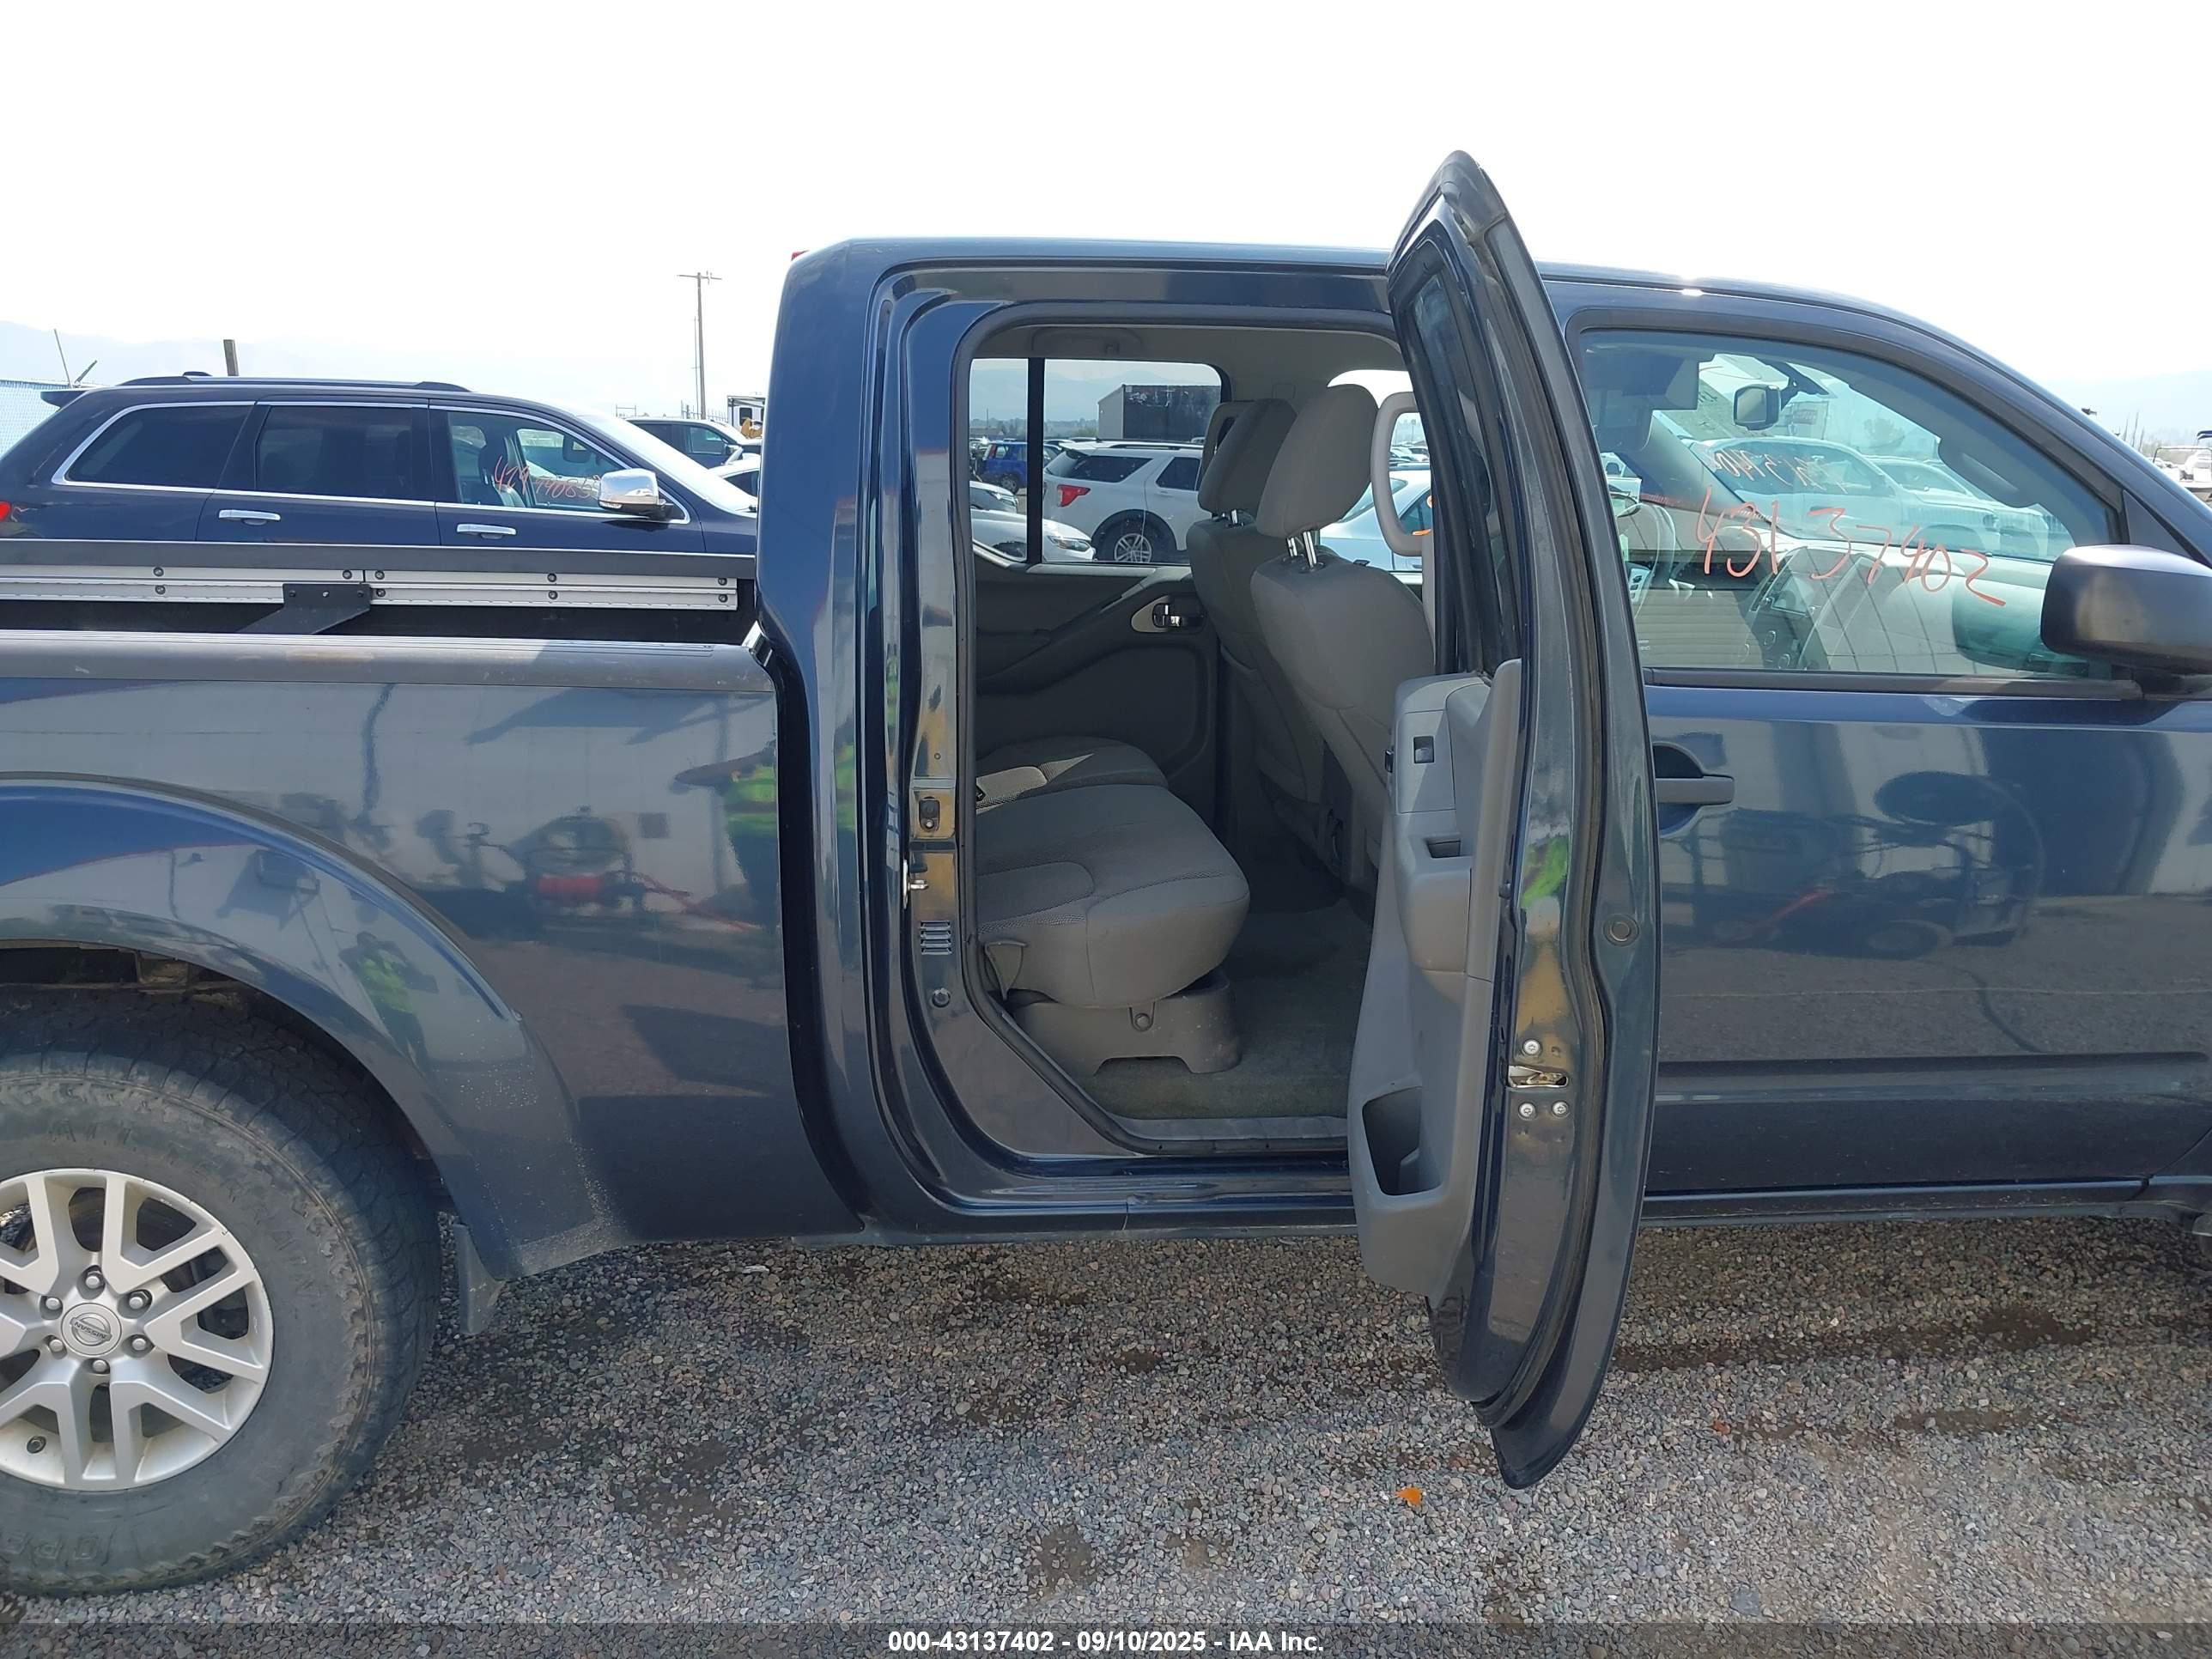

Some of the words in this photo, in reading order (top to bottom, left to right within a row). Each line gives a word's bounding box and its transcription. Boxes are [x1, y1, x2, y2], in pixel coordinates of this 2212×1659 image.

[1697, 485, 1779, 579] 431
[1808, 507, 2007, 607] 37402
[74, 1321, 108, 1340] NISSAN
